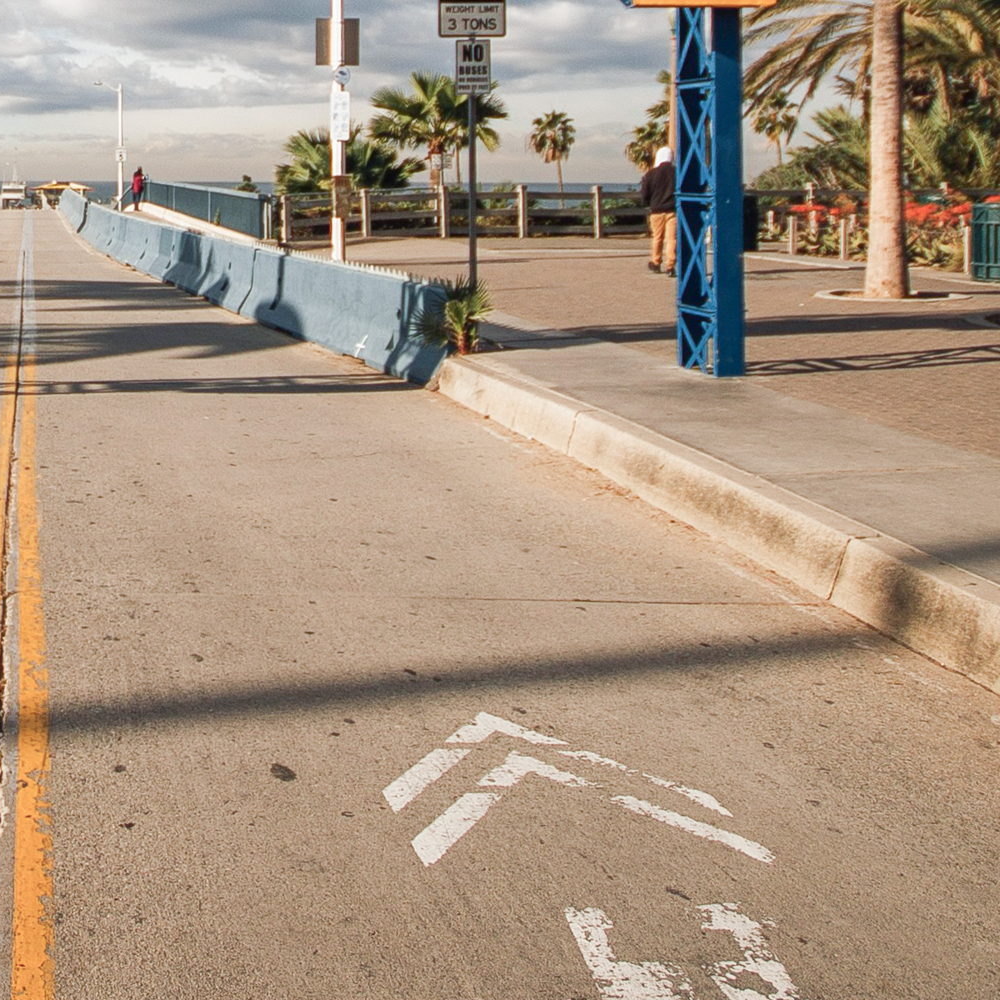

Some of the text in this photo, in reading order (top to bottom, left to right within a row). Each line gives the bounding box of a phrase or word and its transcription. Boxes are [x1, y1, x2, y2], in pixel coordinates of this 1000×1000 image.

[445, 5, 499, 14] WEIGHT LIMIT
[447, 18, 497, 31] 3 TONS
[462, 44, 484, 62] NO
[459, 65, 488, 75] BUSES
